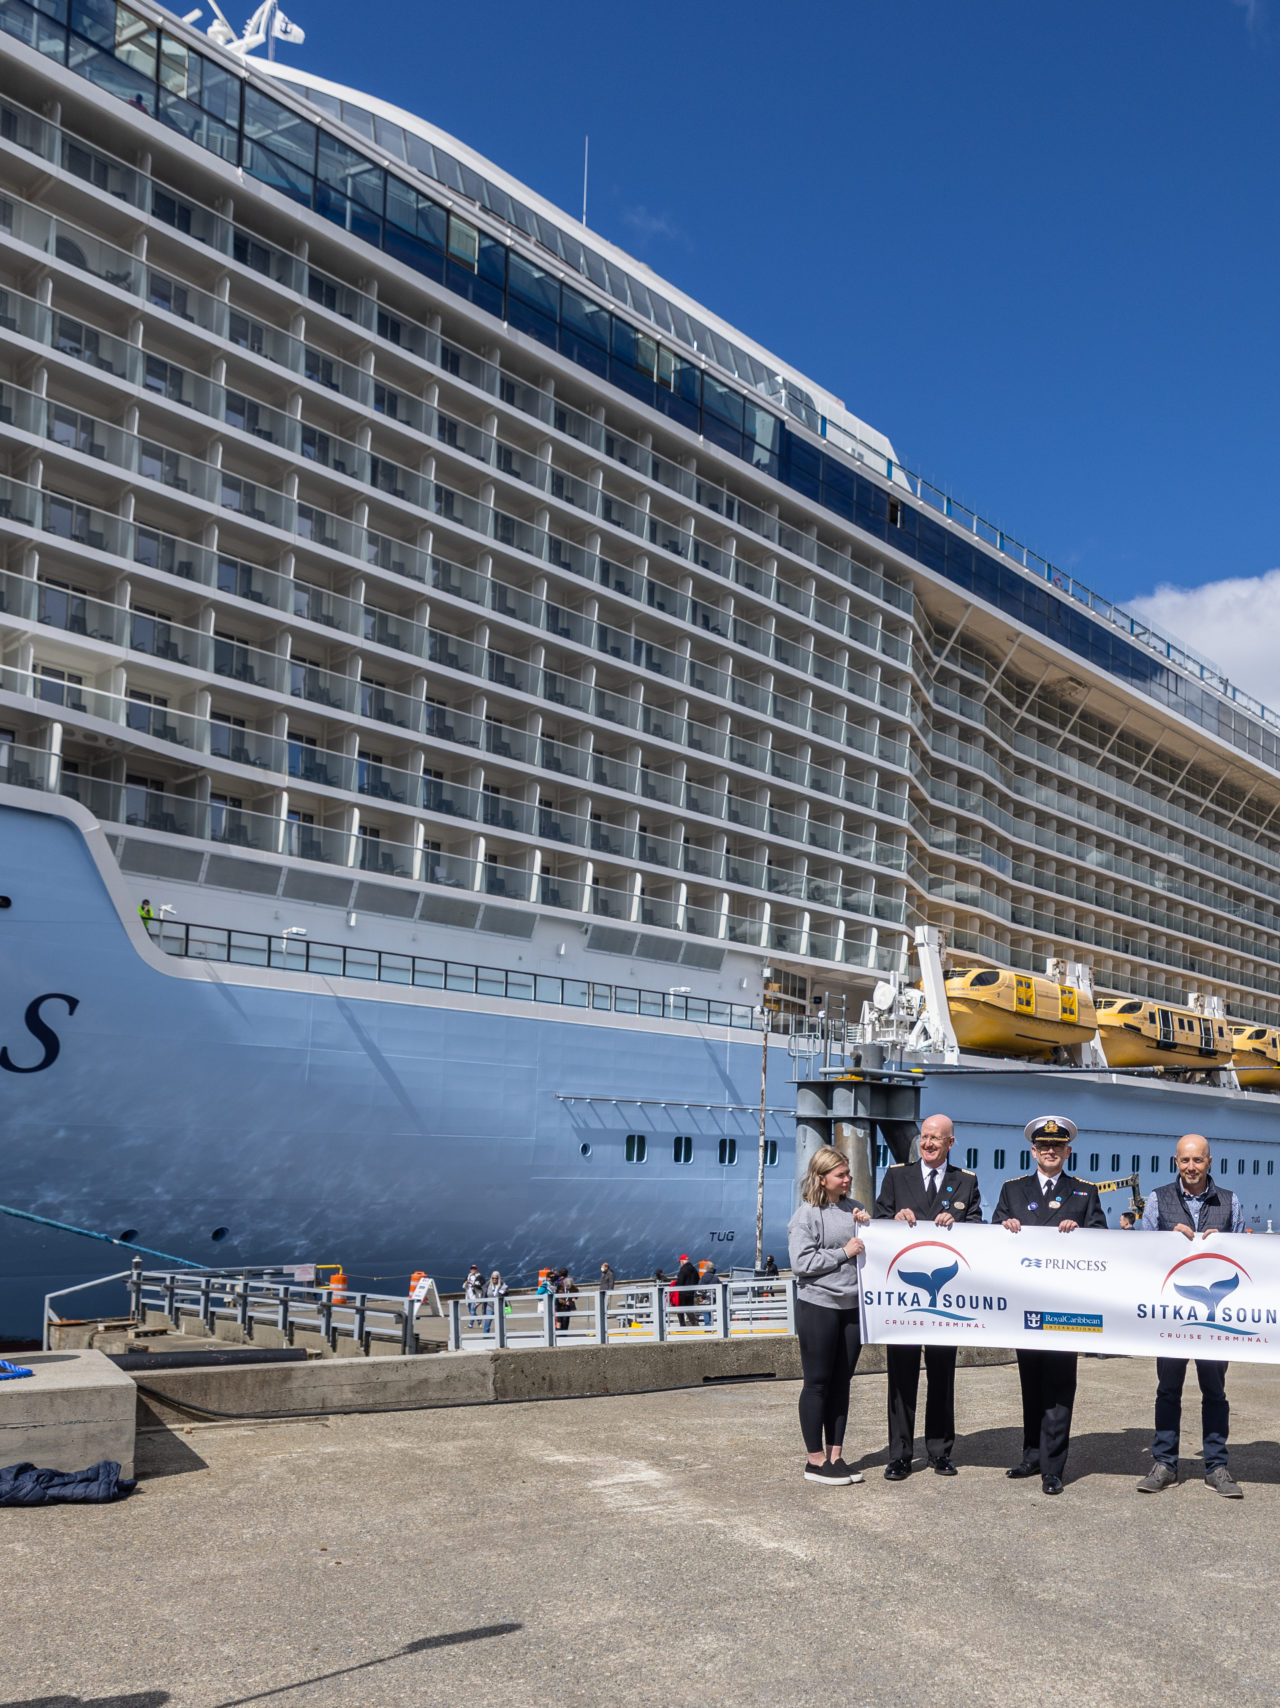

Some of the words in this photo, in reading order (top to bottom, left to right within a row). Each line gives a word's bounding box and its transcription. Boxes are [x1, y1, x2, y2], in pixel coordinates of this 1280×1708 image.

[0, 993, 80, 1073] S
[709, 1231, 735, 1241] TUG
[1045, 1258, 1107, 1272] PRINCESS
[864, 1291, 921, 1307] SITKA
[942, 1293, 1008, 1311] SOUND
[1136, 1303, 1199, 1321] SITKA
[932, 1321, 987, 1329] TERMINAL
[1159, 1332, 1202, 1340] CRUISE
[1210, 1335, 1269, 1343] TERMINAL
